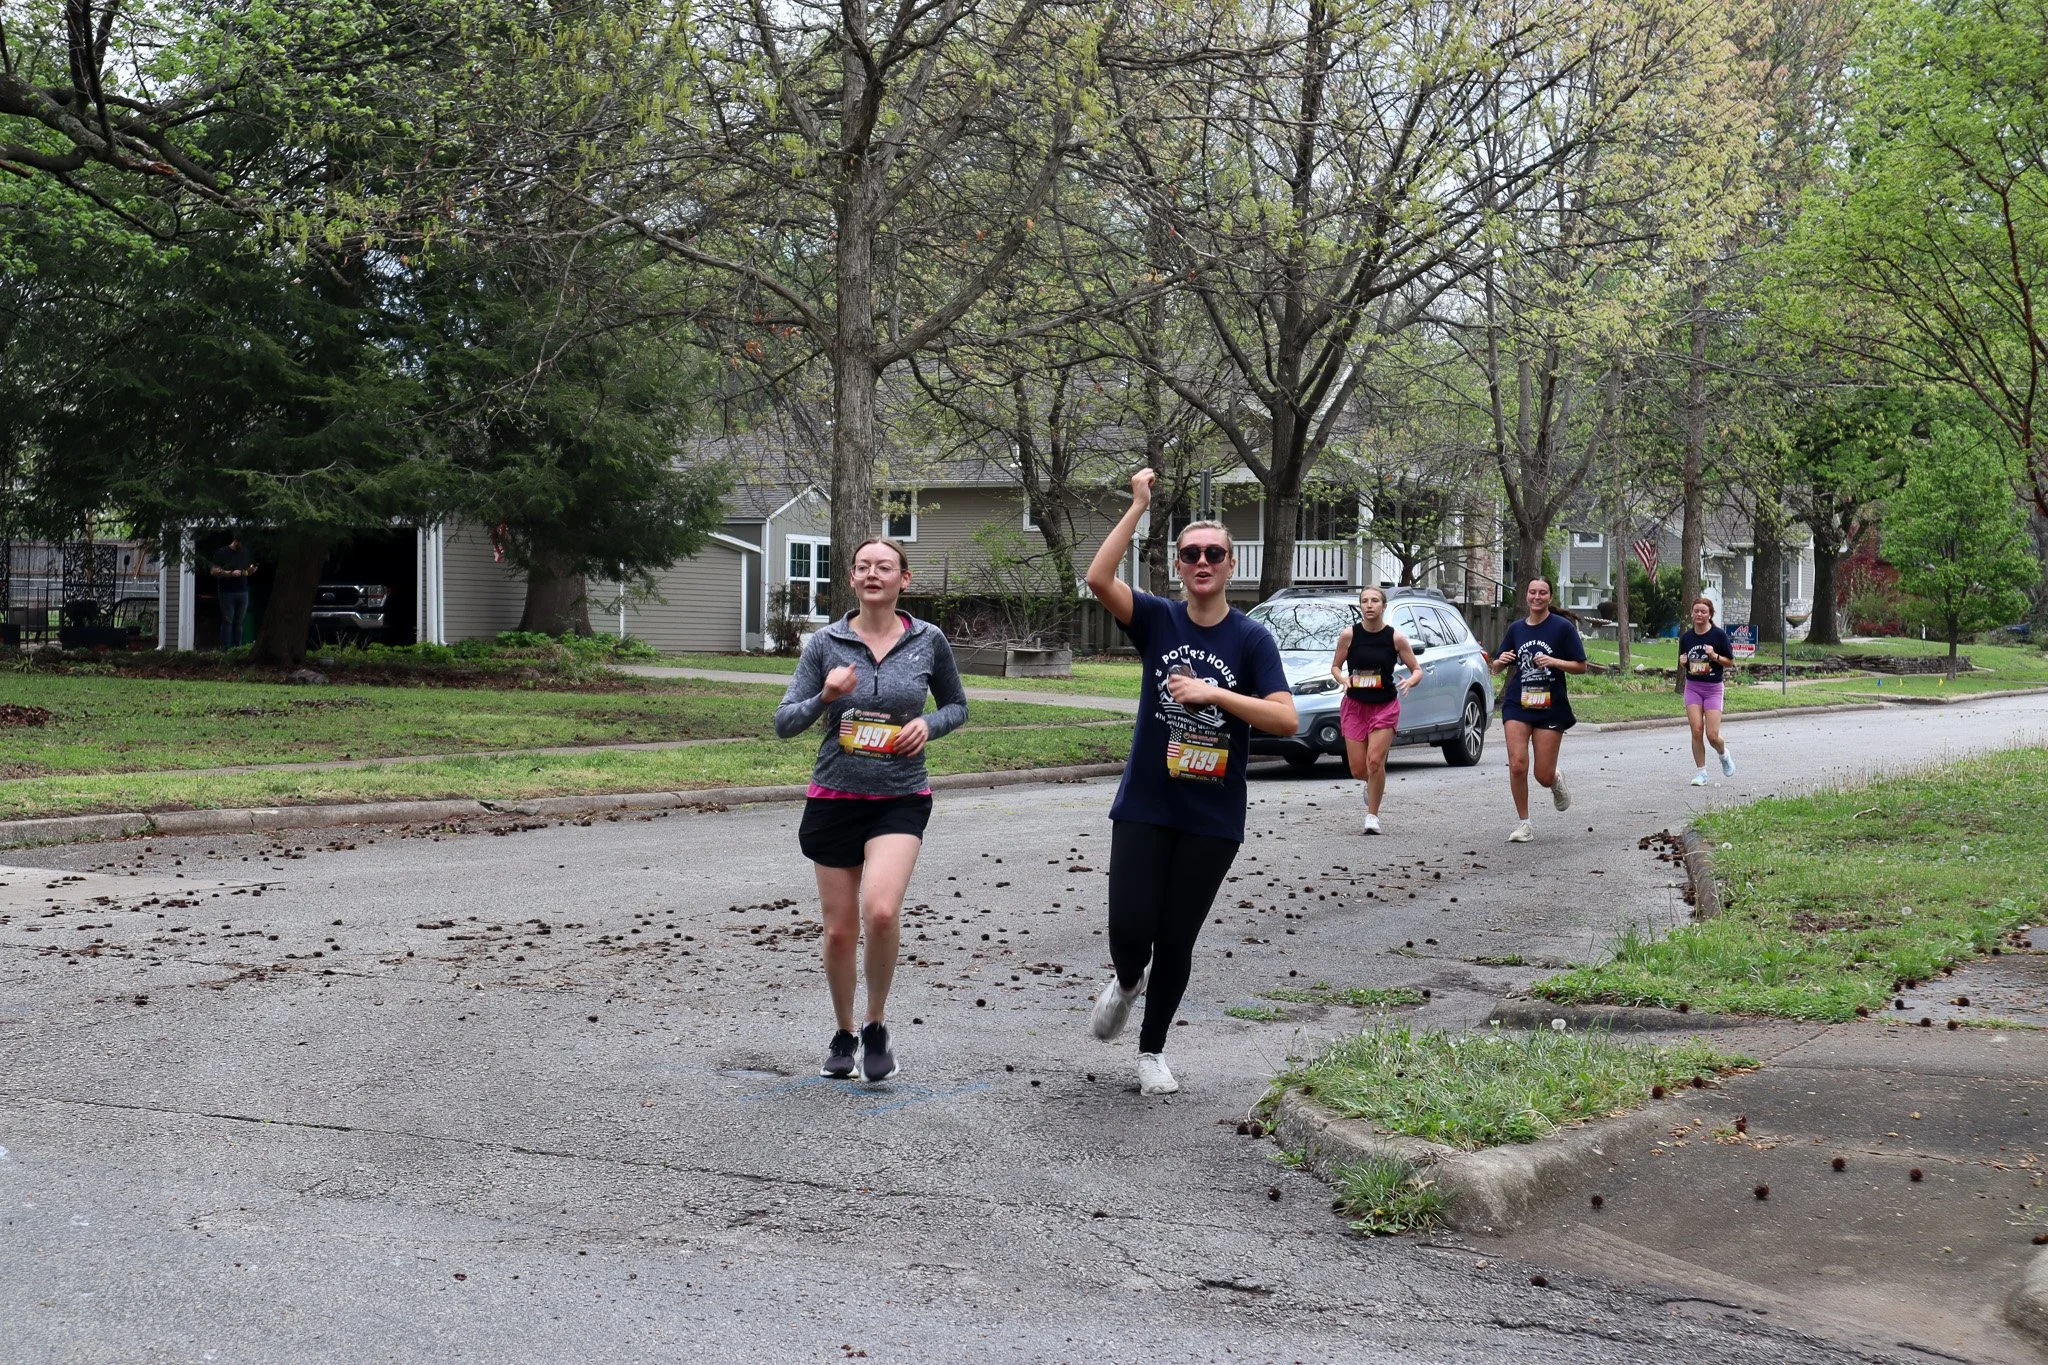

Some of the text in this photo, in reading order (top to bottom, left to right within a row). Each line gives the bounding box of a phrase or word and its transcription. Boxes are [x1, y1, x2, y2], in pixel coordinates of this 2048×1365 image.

[1537, 640, 1553, 654] HOUSE
[1162, 645, 1237, 688] POTTR'S HOUSE
[1167, 719, 1187, 730] NUAL
[854, 725, 892, 748] 1997
[1179, 748, 1219, 772] 2139
